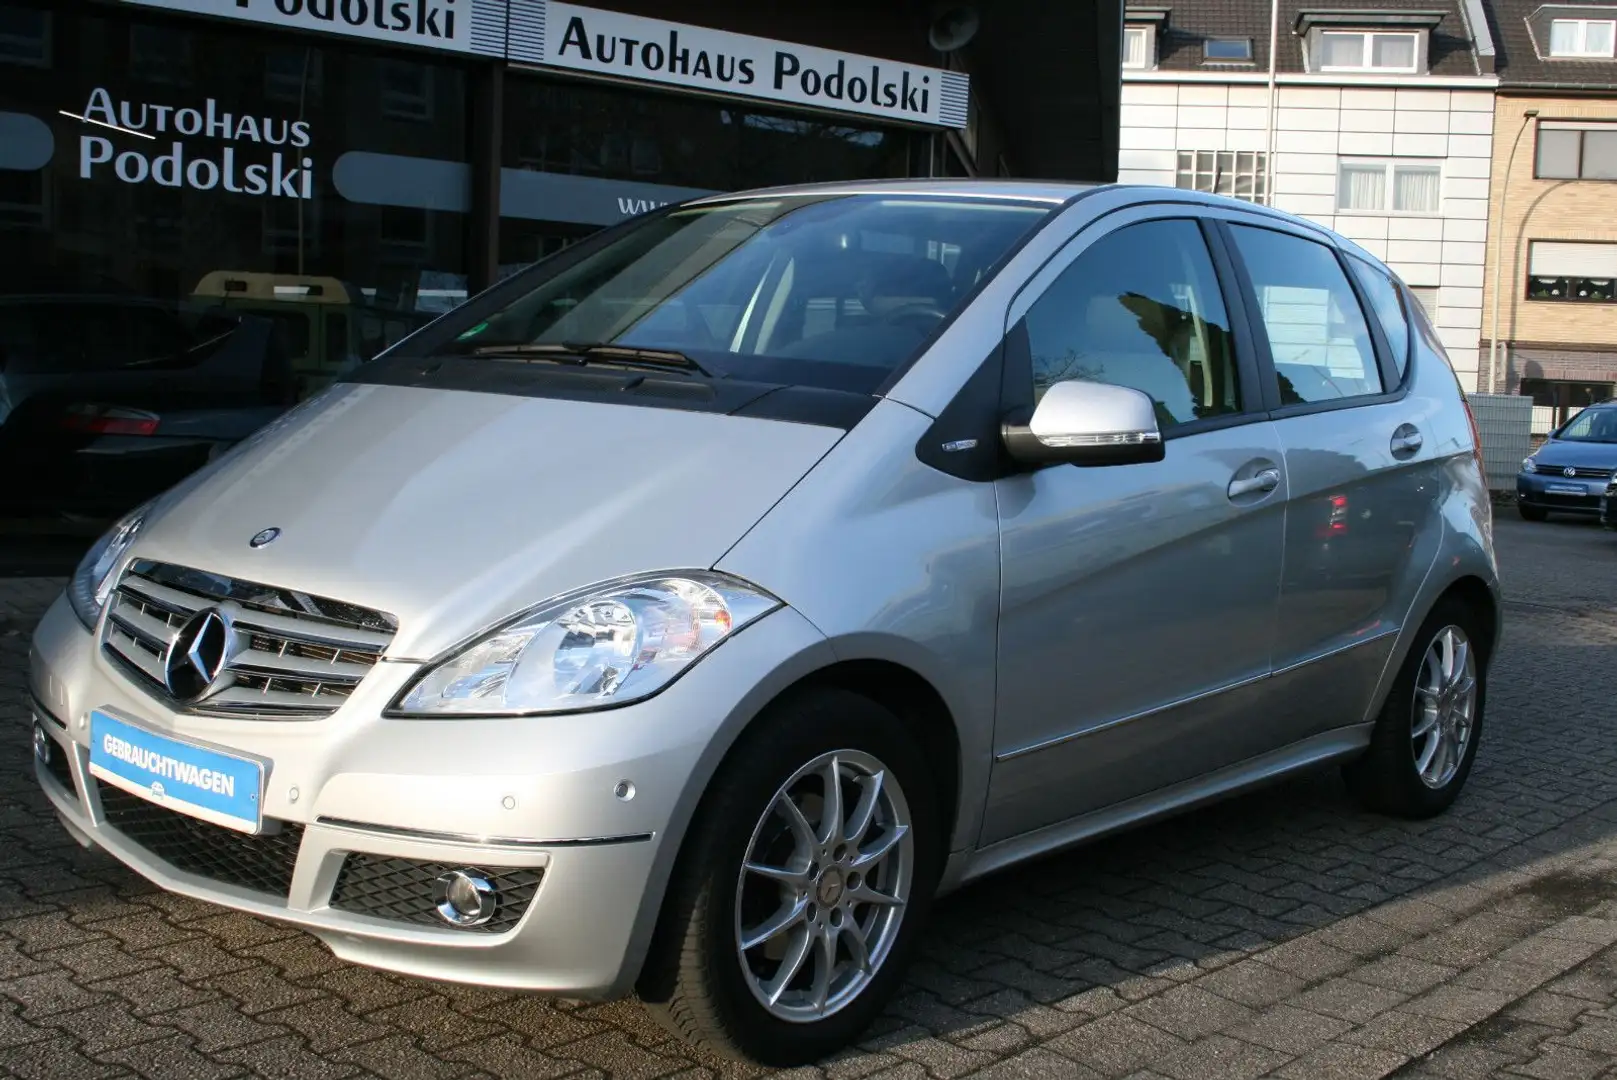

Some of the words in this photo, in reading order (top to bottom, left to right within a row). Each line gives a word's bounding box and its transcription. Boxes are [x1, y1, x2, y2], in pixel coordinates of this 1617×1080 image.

[236, 0, 454, 39] odolski
[773, 51, 930, 113] Podolski
[80, 135, 312, 199] Podolski
[103, 733, 235, 797] GEBRAUCHTWAGEN
